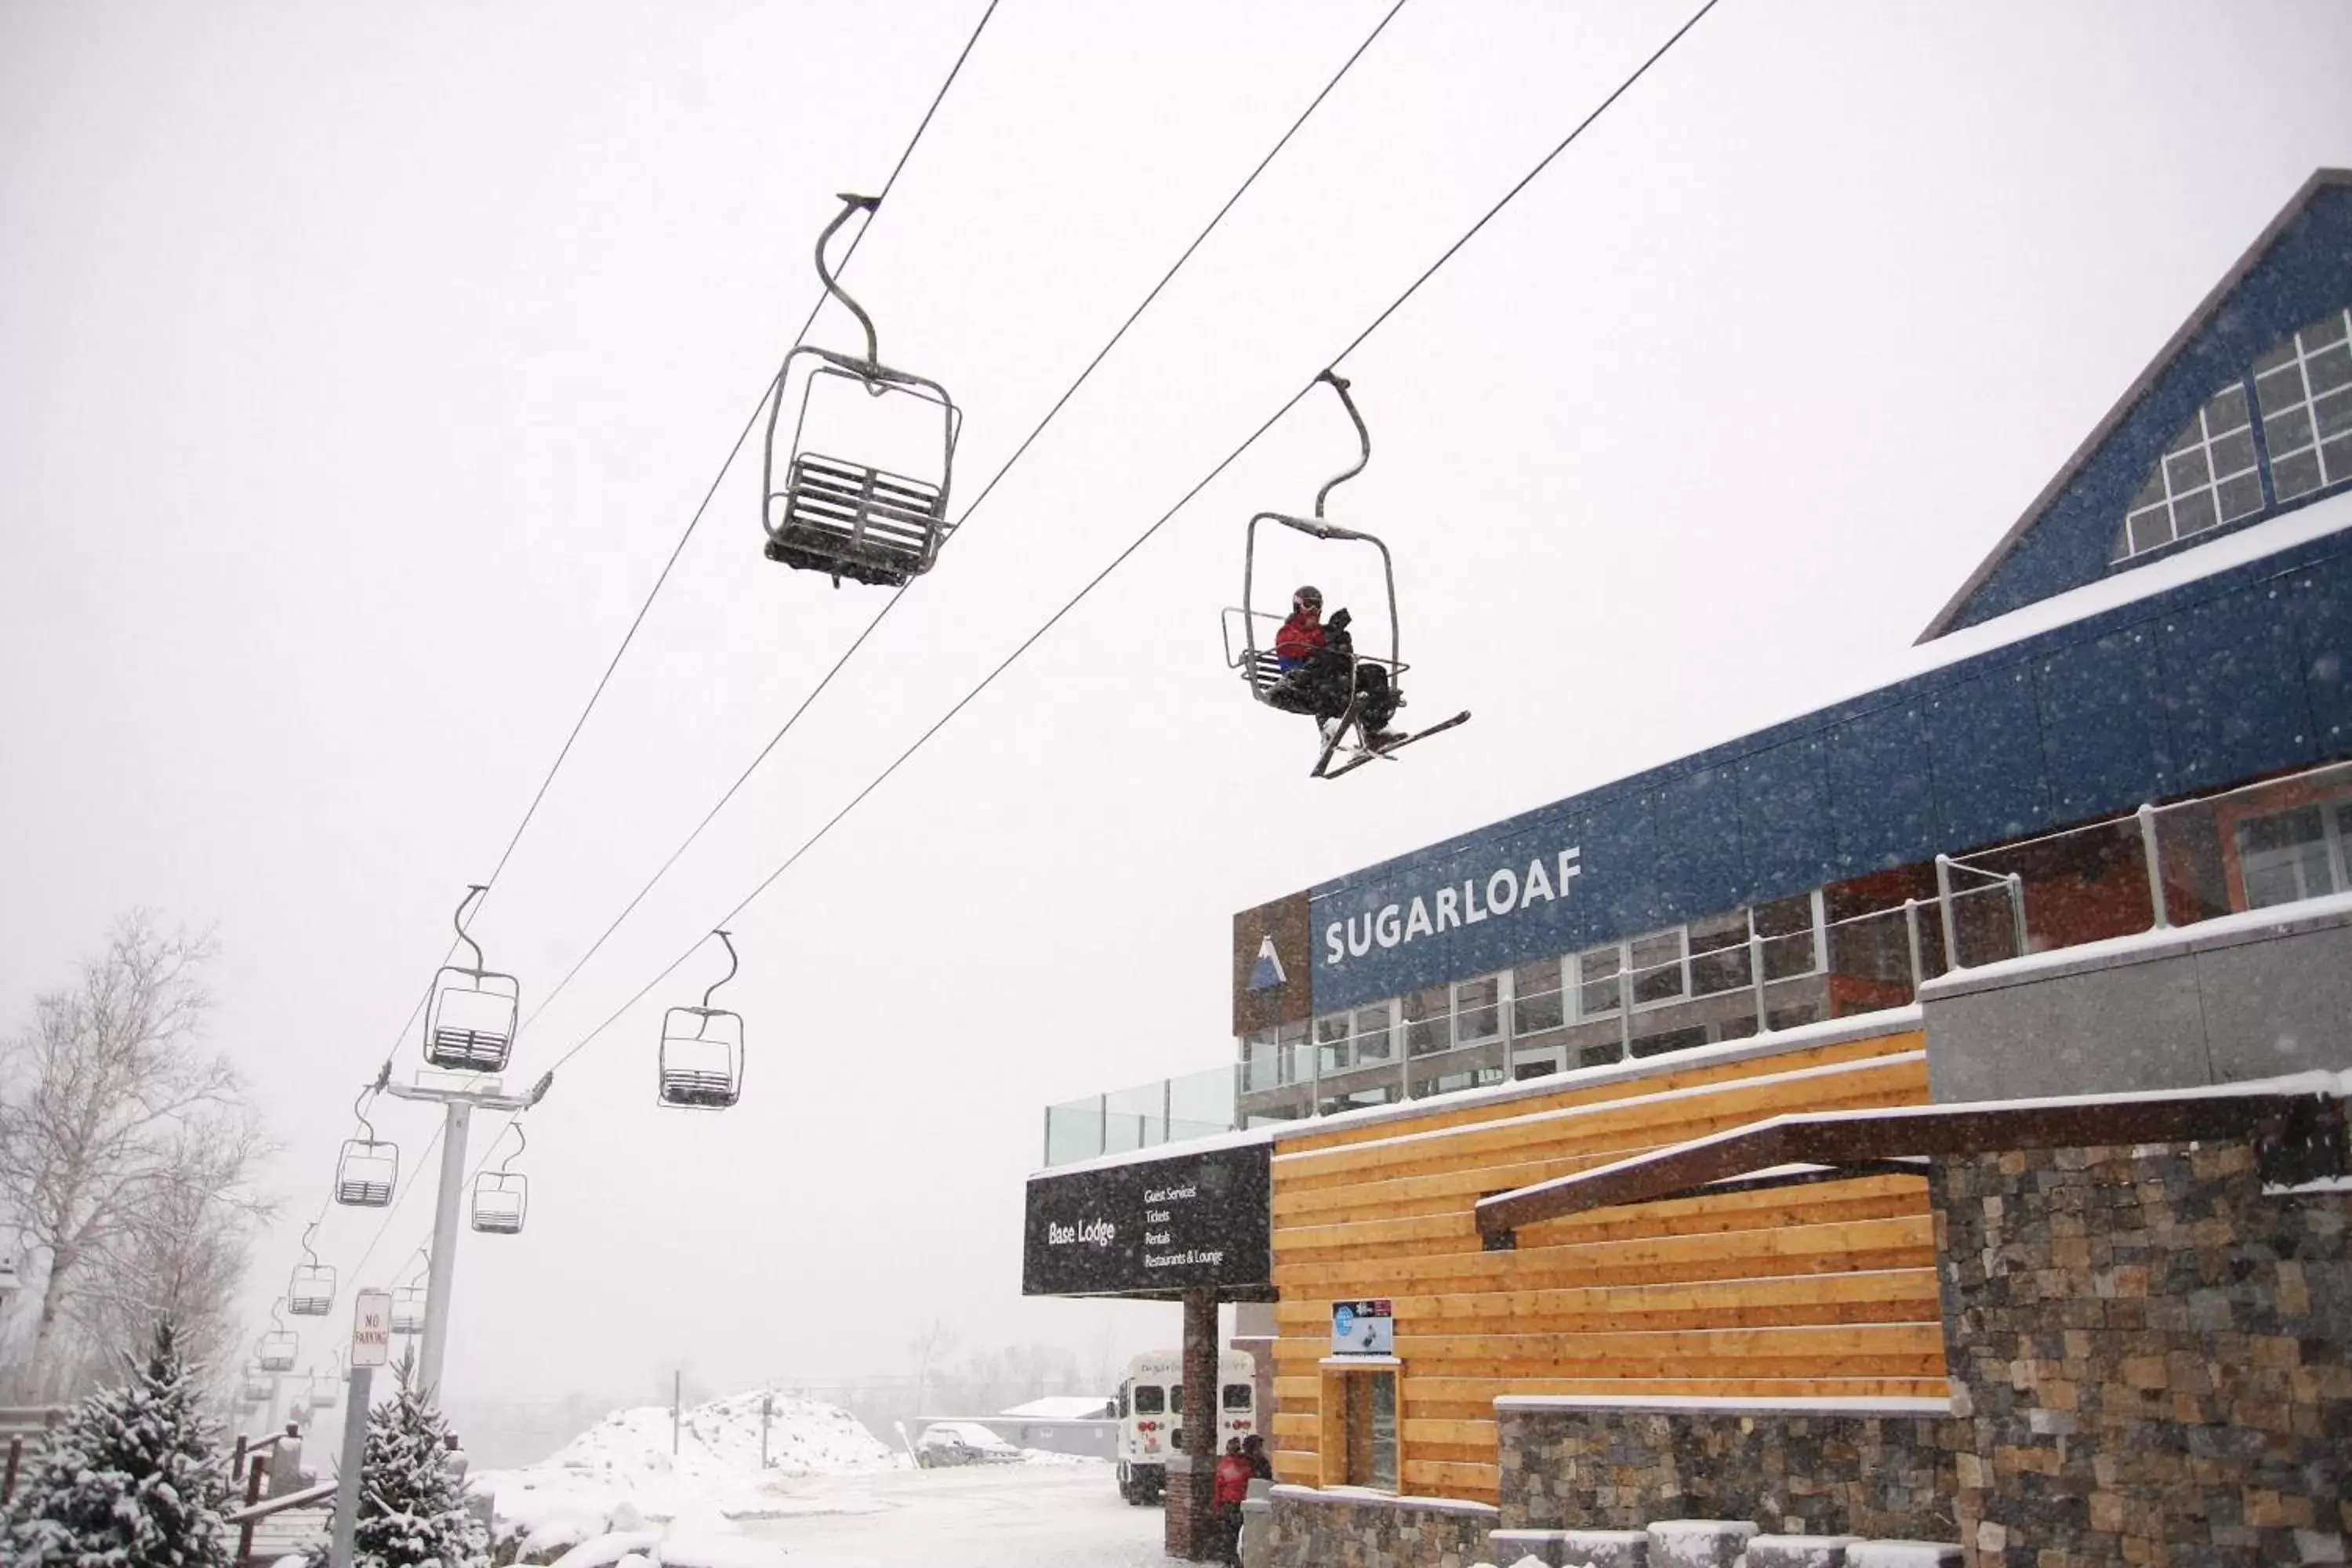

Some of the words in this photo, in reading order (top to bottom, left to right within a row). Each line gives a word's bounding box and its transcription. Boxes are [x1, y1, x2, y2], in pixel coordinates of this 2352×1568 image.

[1326, 846, 1582, 964] SUGARLOAF
[1145, 1189, 1165, 1203] Guest
[1166, 1185, 1196, 1200] Services
[1146, 1210, 1170, 1224] Tickets
[1049, 1221, 1075, 1244] Base
[1078, 1218, 1114, 1247] Lodge
[1145, 1232, 1170, 1245] Rentals
[1145, 1253, 1185, 1268] Restaurants
[1187, 1250, 1194, 1264] &
[1195, 1249, 1224, 1265] Lounge
[365, 1315, 379, 1327] NO
[356, 1331, 387, 1344] PARKING
